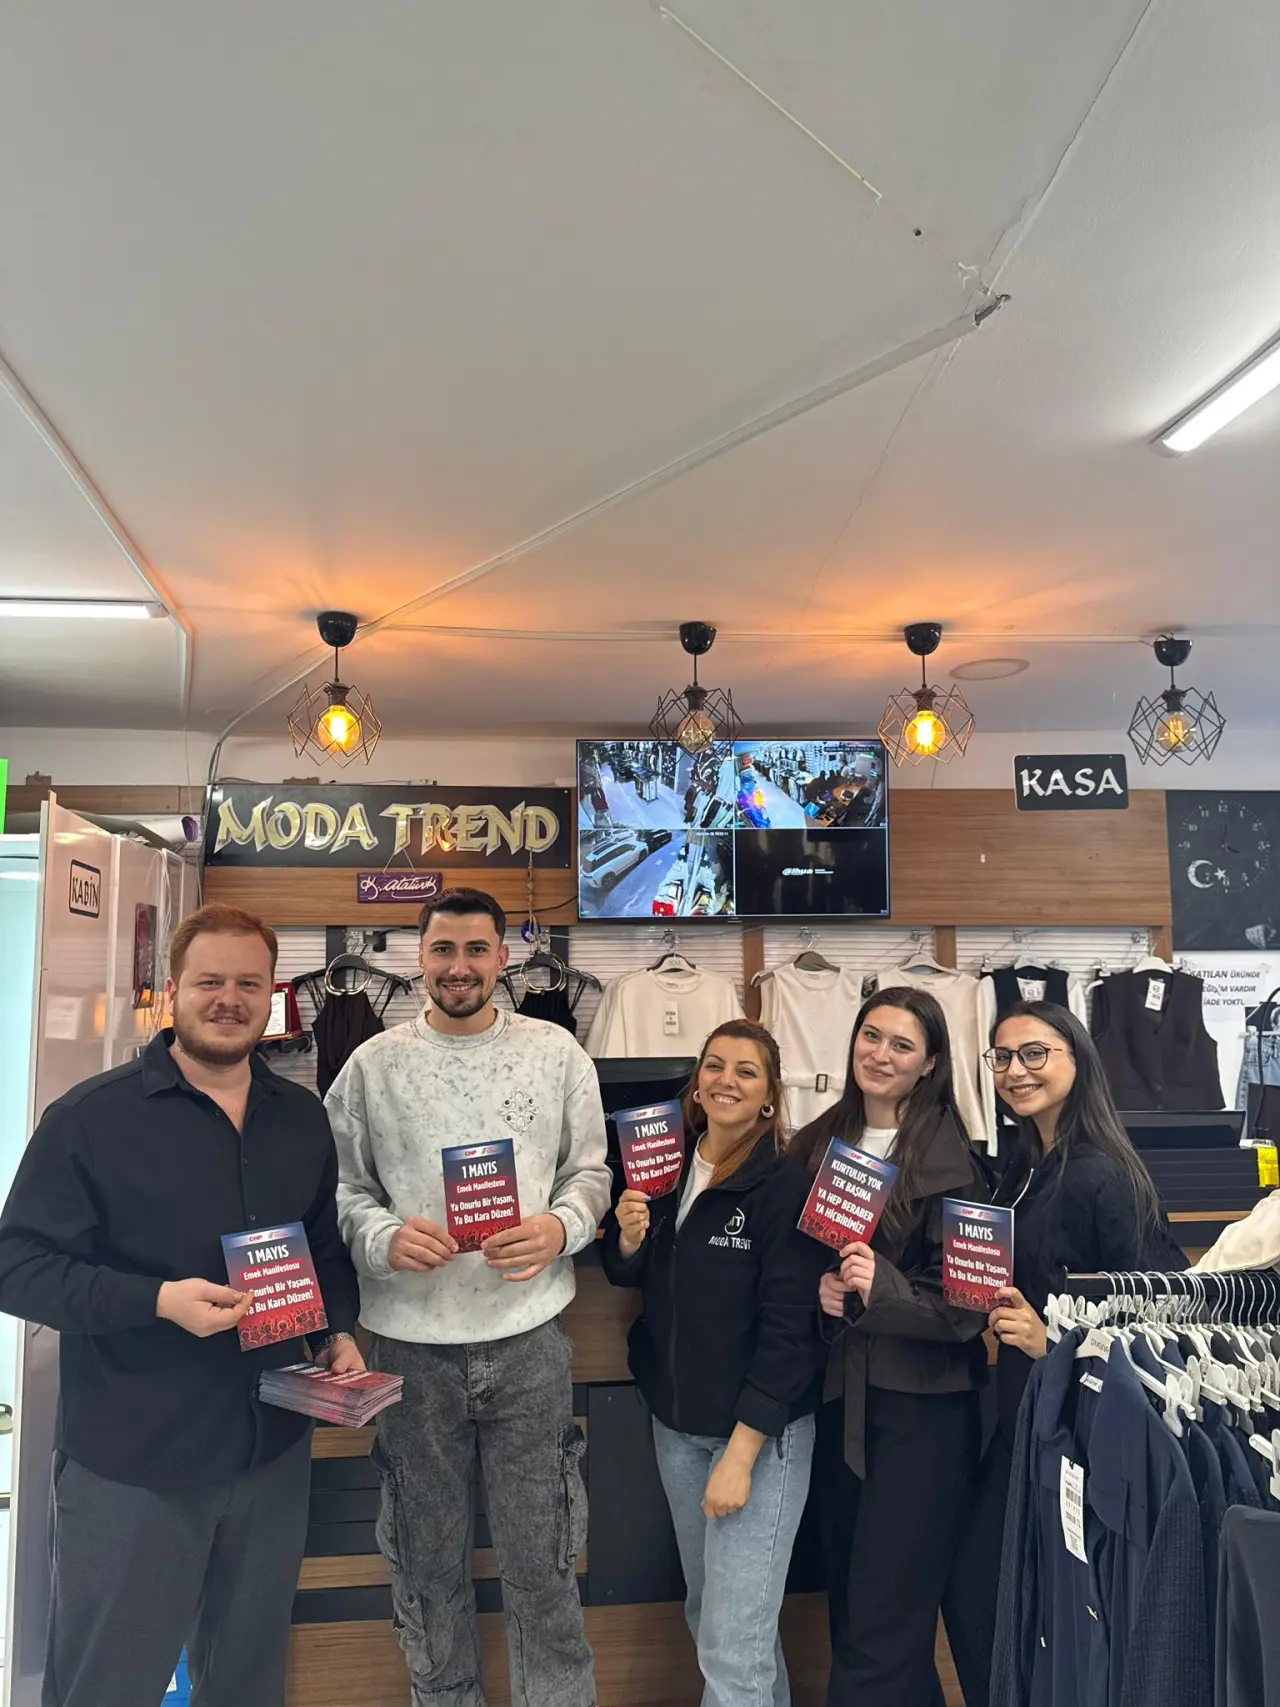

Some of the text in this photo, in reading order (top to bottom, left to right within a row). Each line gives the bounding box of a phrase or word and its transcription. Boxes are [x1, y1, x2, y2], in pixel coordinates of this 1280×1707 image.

[1020, 768, 1124, 797] KASA
[214, 796, 560, 856] MODA TREND
[72, 876, 99, 907] KABİN
[1230, 970, 1261, 978] ÜRÜNDE
[634, 1121, 668, 1138] 1 MAYIS
[632, 1144, 646, 1152] Emek
[462, 1161, 498, 1178] 1 MAYIS
[627, 1161, 635, 1170] Ya
[636, 1158, 655, 1168] Onurlu
[656, 1155, 664, 1164] Bir
[632, 1173, 640, 1182] Ya
[640, 1170, 649, 1180] Bu
[650, 1168, 663, 1178] Kara
[831, 1159, 867, 1184] KURTULUŞ
[868, 1176, 883, 1190] YOK
[456, 1180, 506, 1194] Emek Manifestosu
[832, 1176, 872, 1202] TEK BAŞINA
[450, 1196, 514, 1212] Ya Onurlu Bir Yaşam,
[817, 1187, 874, 1222] YA HEP BERABER
[454, 1207, 514, 1226] Ya Bu Kara Düzen!
[815, 1202, 866, 1235] YA HİÇBİRİMİZ!
[249, 1234, 262, 1242] CHP
[958, 1222, 993, 1240] 1 MAYIS
[952, 1240, 967, 1249] Emek
[247, 1244, 289, 1265] 1 MAYIS
[244, 1262, 300, 1280] Emek Manifestosu
[946, 1254, 1010, 1276] Ya Onurlu Bir Yaşam,
[275, 1282, 286, 1292] Bir
[287, 1277, 314, 1289] Yaşam,
[949, 1268, 1006, 1288] Ya Bu Kara Düzen!
[255, 1303, 266, 1314] Bu
[268, 1298, 286, 1310] Kara
[287, 1289, 314, 1304] Düzen!
